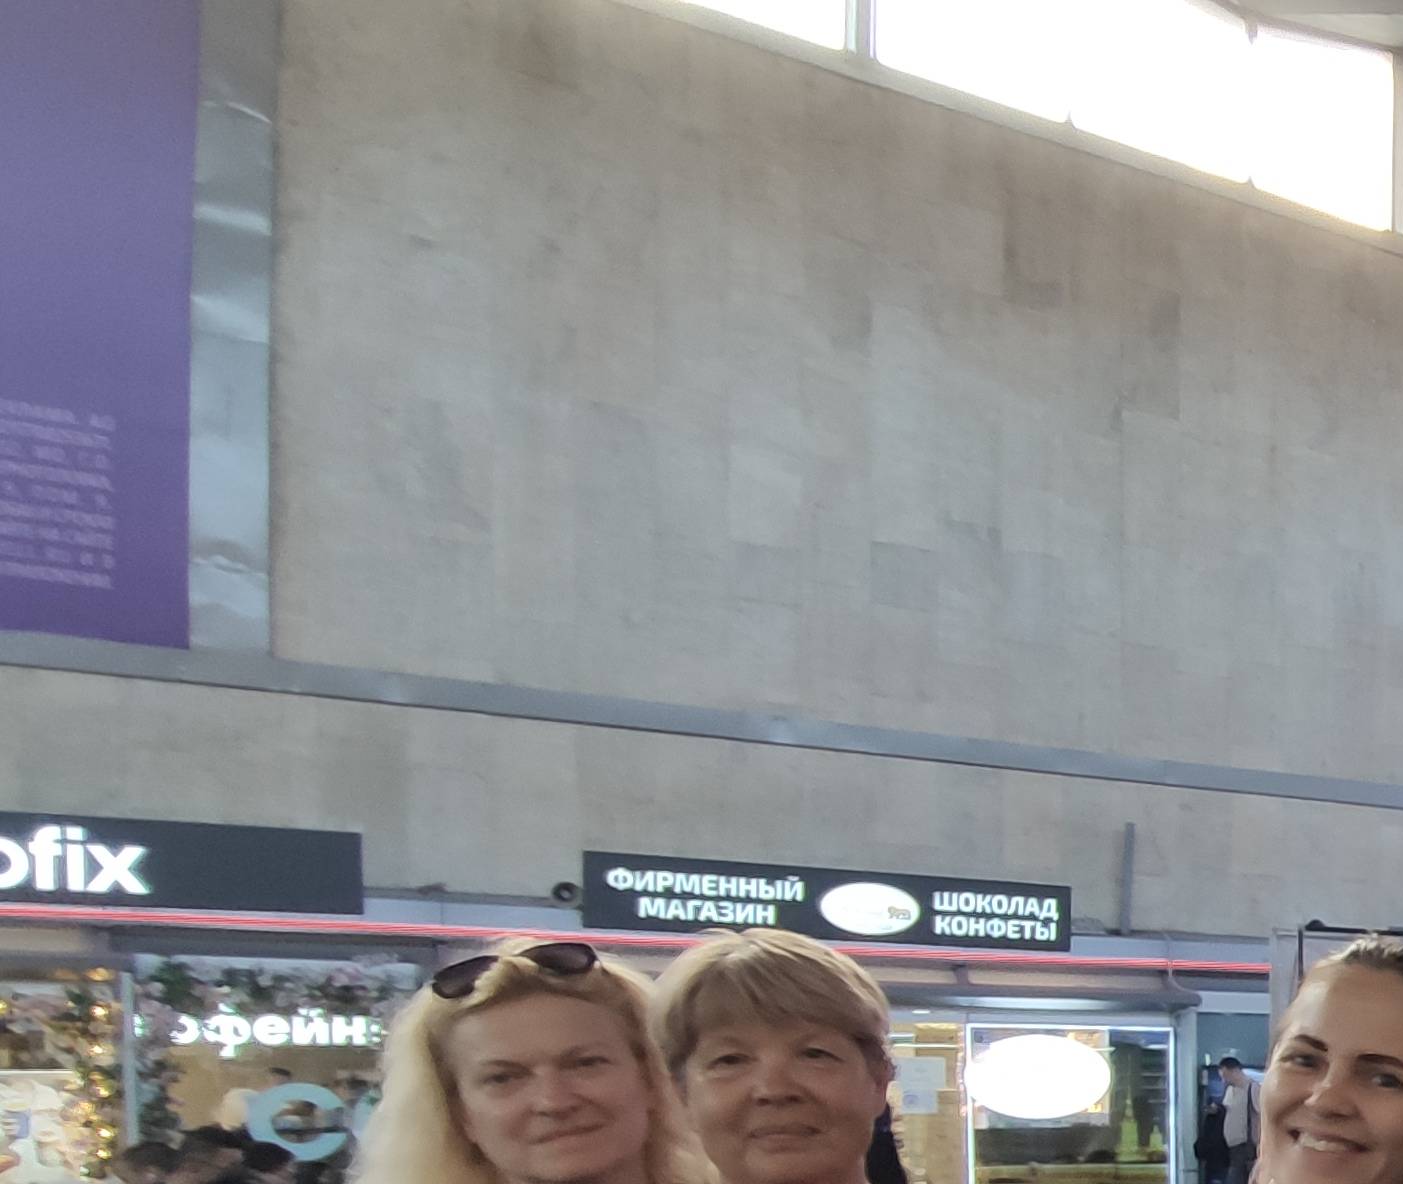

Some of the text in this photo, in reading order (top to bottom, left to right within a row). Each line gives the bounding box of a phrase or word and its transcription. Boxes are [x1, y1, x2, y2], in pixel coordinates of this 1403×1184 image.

[605, 866, 806, 902] ФИРМЕННЫЙ
[637, 896, 777, 926] МАГАЗИН
[932, 890, 1060, 922] ШОКОЛАД
[933, 915, 1058, 942] КОНФЕТЫ
